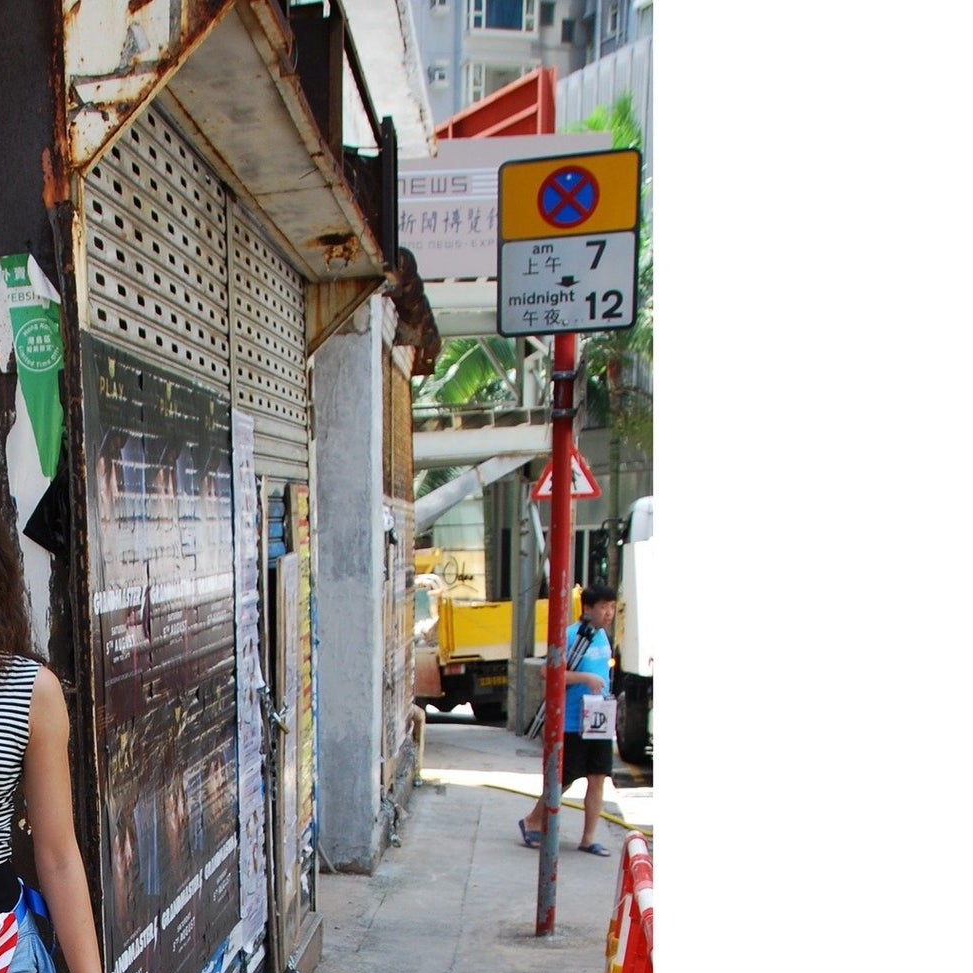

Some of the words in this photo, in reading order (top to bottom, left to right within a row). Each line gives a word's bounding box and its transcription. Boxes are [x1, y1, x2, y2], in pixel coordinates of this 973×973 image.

[522, 256, 562, 276] 上午
[532, 242, 554, 255] am
[586, 239, 607, 270] 7
[508, 289, 575, 307] midnight
[585, 289, 624, 320] 12
[522, 308, 561, 327] 午夜
